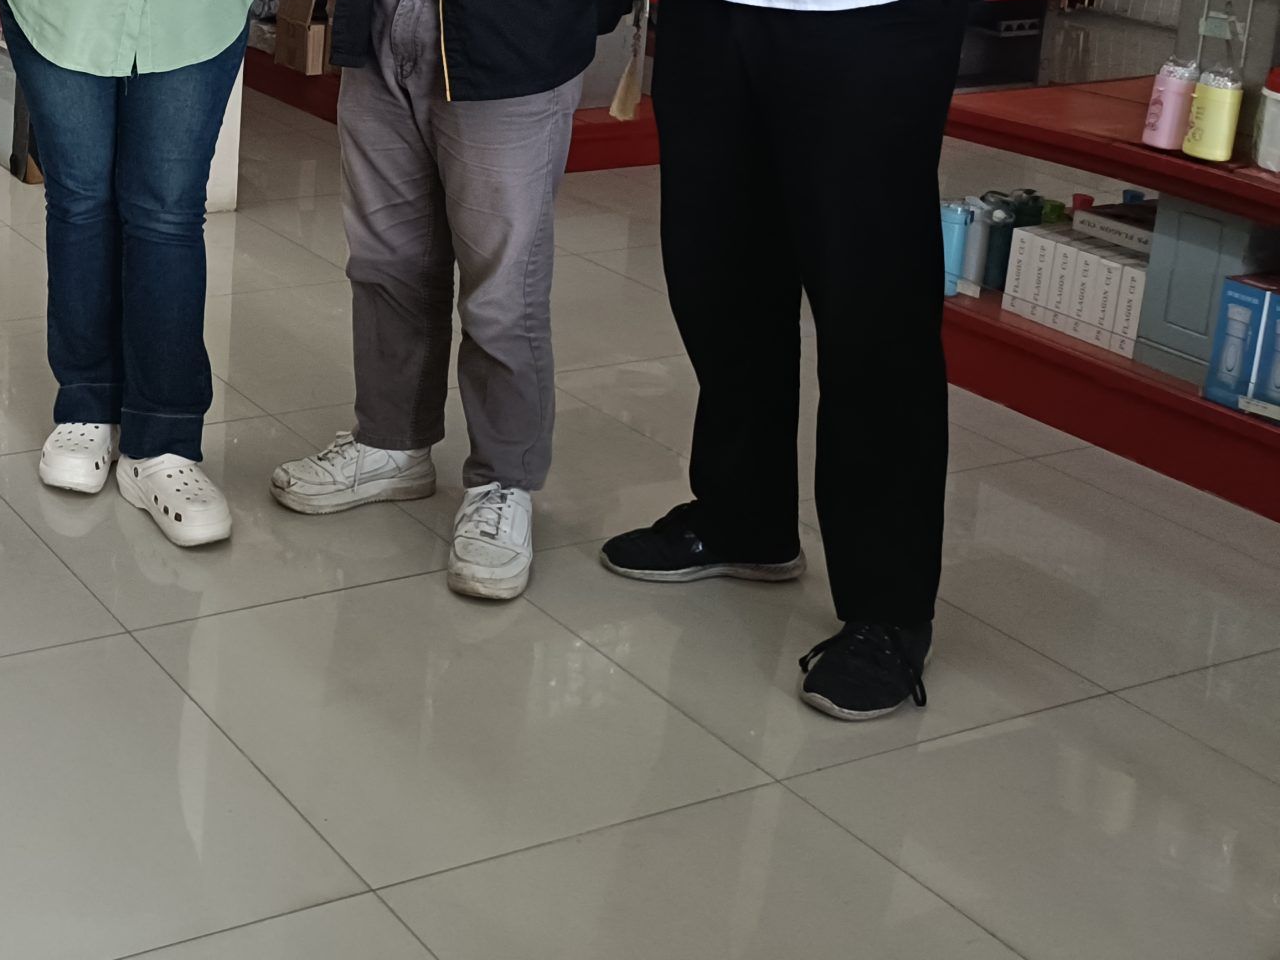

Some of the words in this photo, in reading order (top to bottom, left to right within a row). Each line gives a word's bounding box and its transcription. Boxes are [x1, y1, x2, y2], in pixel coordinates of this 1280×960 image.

[1012, 259, 1023, 294] FLAGON
[1018, 237, 1026, 256] CUP
[1033, 267, 1043, 302] FLAGON
[1039, 244, 1048, 263] CUP
[1055, 274, 1065, 310] FLAGON
[1061, 252, 1070, 271] CUP
[1076, 282, 1087, 318] FLAGON
[1082, 259, 1090, 278] CUP
[1098, 290, 1109, 327] FLAGON
[1104, 267, 1113, 286] CUP
[1122, 299, 1134, 336] FLAGON
[1128, 275, 1137, 295] CUP
